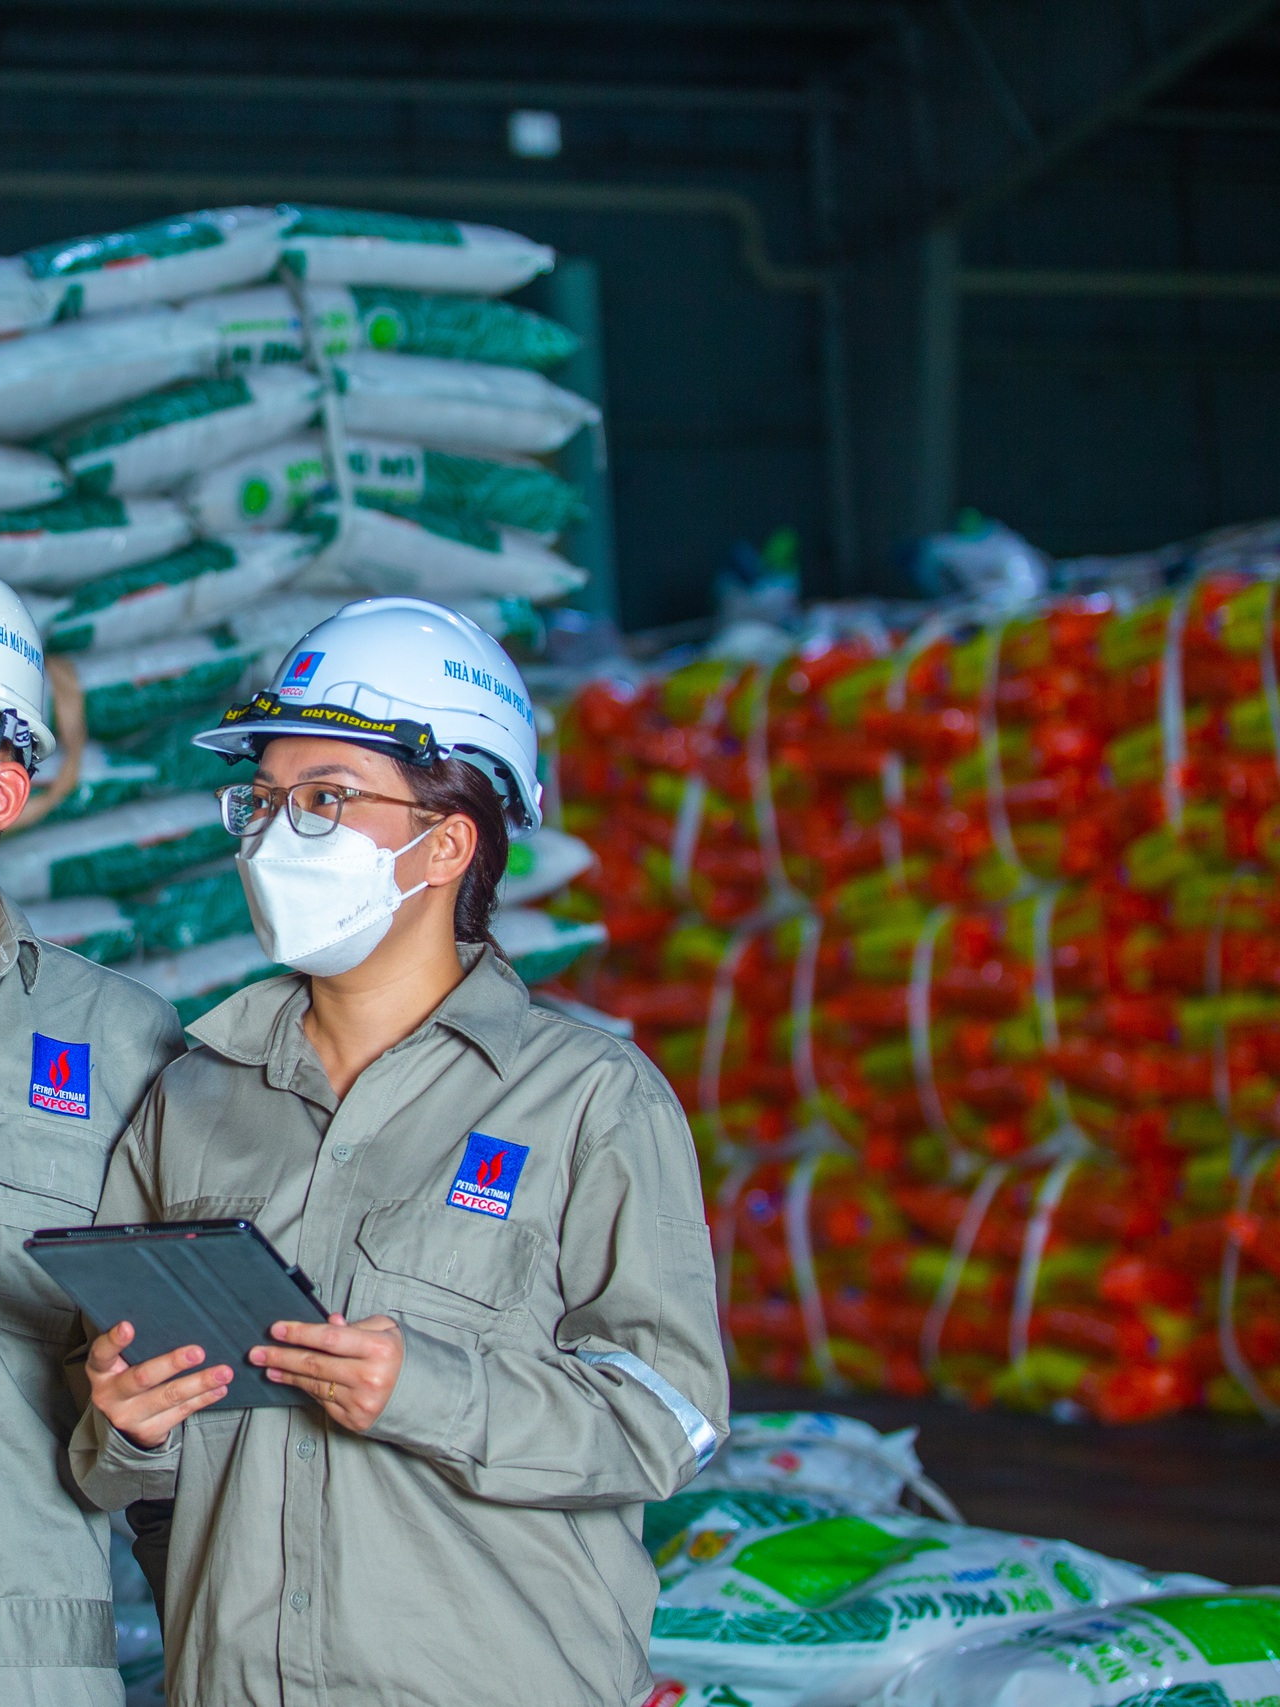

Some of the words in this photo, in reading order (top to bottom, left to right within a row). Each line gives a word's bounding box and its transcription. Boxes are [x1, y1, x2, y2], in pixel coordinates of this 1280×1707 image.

[444, 659, 469, 682] NHÀ
[471, 667, 493, 691] MÁY
[494, 678, 512, 704] ĐẠM
[301, 708, 396, 732] PROGUARD
[32, 1083, 86, 1102] PETROVIETNAM
[33, 1093, 85, 1114] PVFCCo
[455, 1179, 511, 1201] PETROVIETNAM
[452, 1192, 505, 1214] PVFCCo
